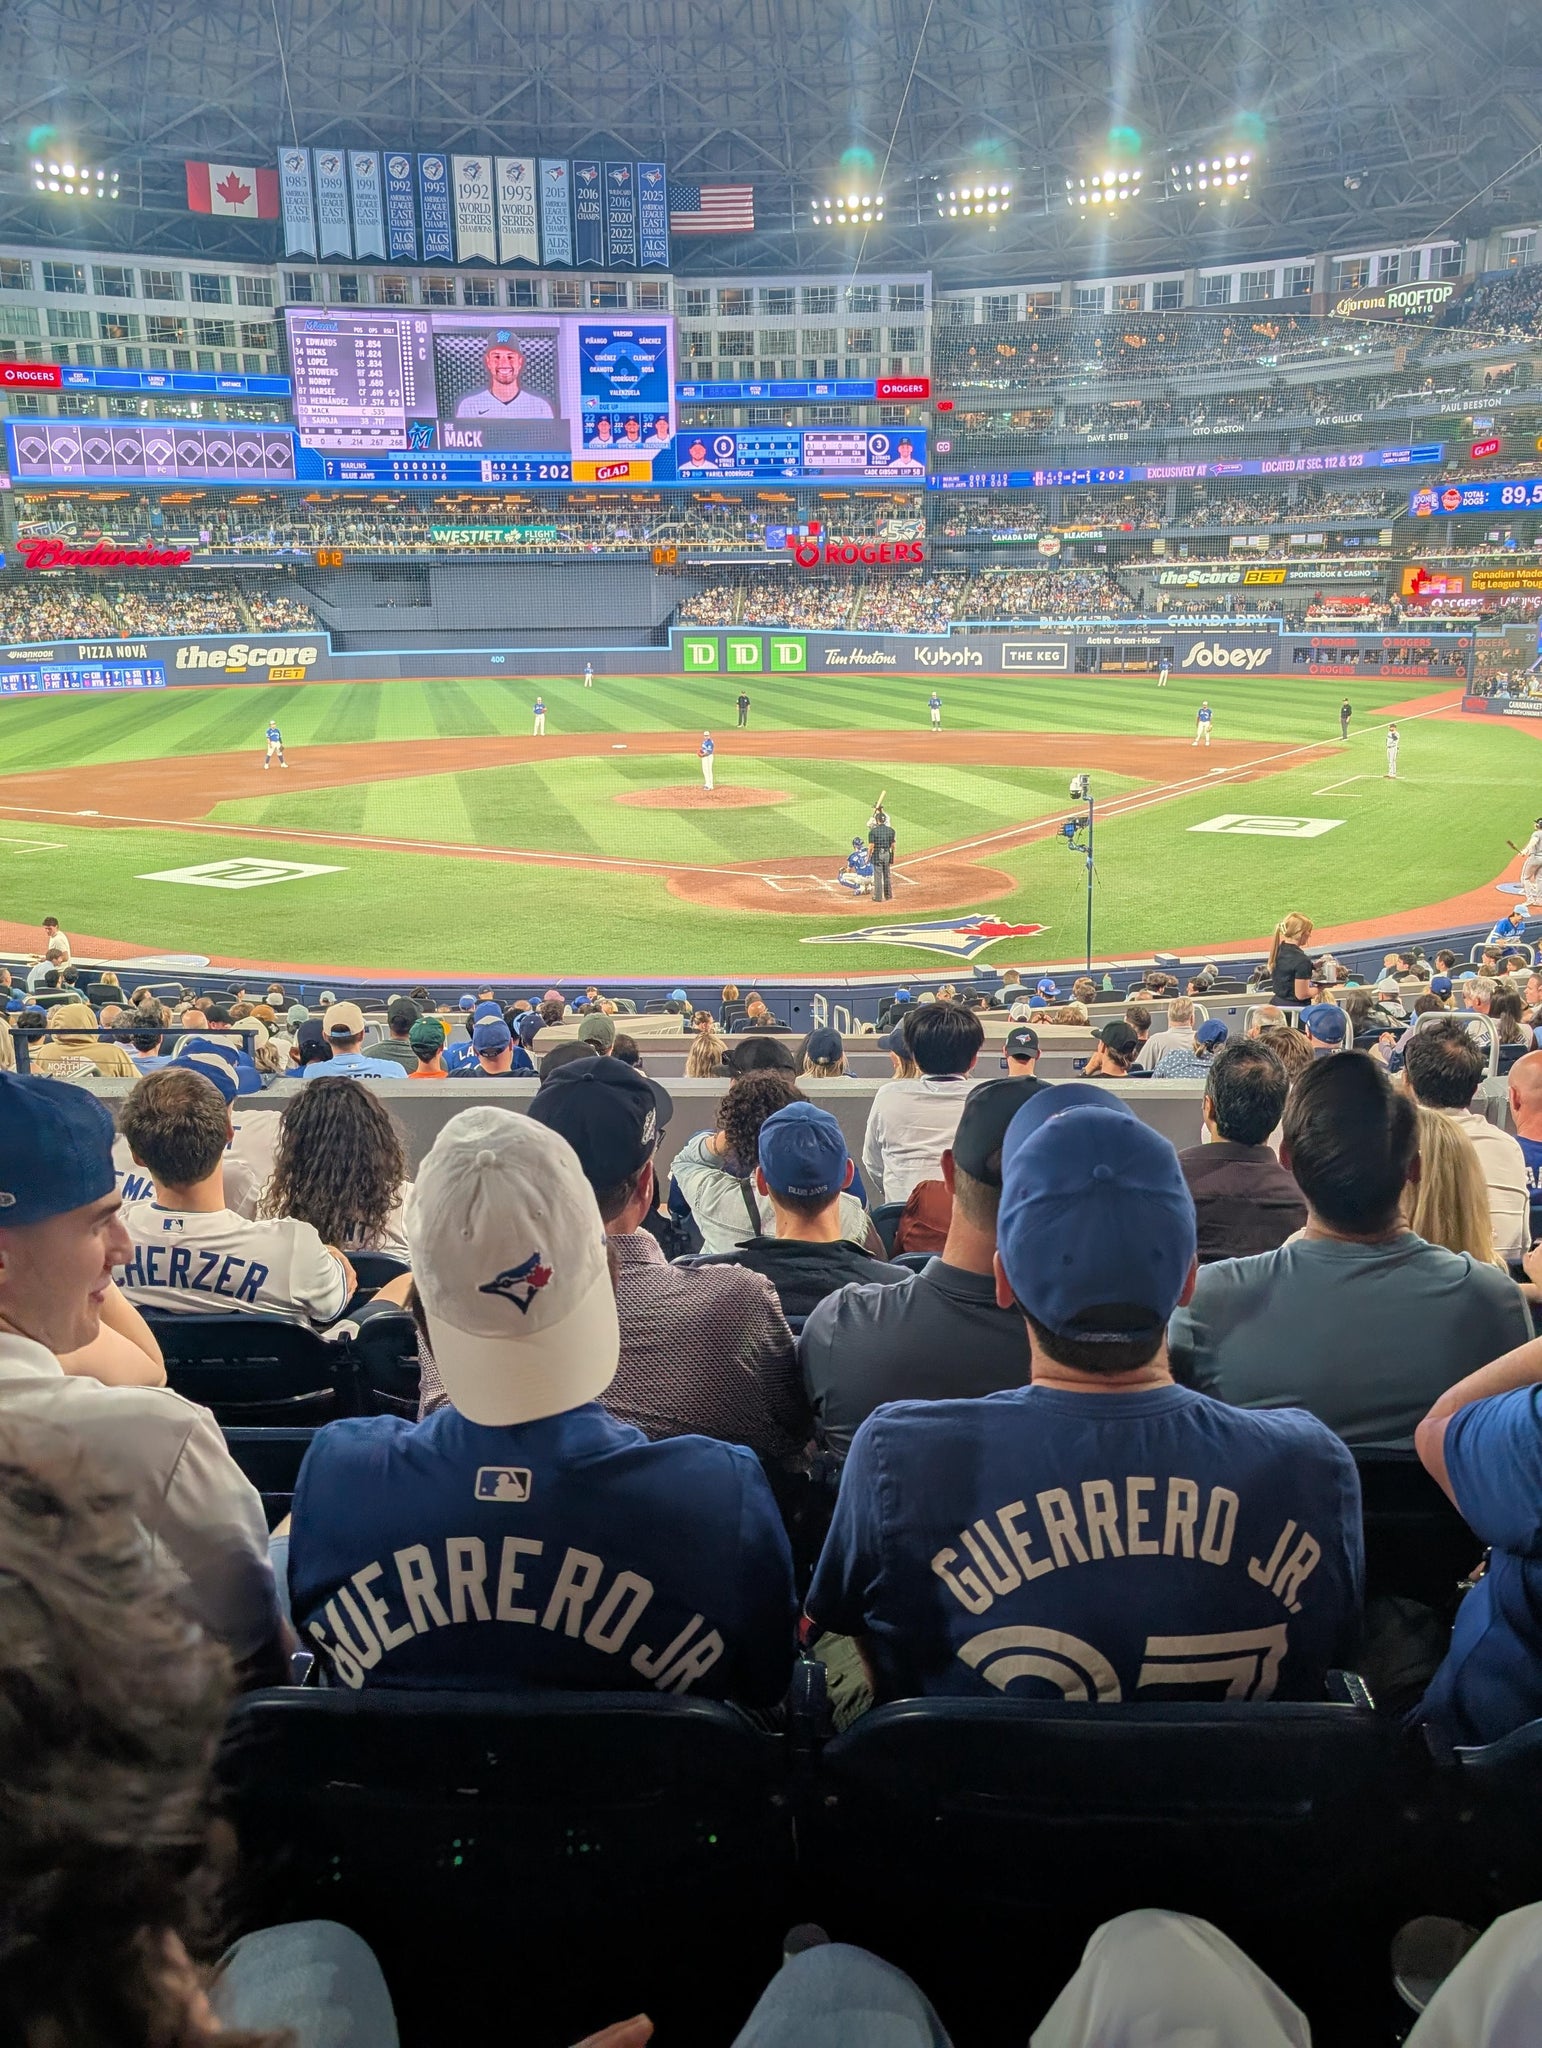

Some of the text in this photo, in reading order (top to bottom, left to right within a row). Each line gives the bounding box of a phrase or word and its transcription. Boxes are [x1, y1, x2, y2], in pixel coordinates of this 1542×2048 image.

[321, 178, 342, 189] 1989
[356, 180, 376, 190] 1991
[390, 181, 411, 191] 1992
[424, 182, 445, 193] 1993
[459, 184, 489, 200] 1992
[502, 185, 532, 201] 1993
[545, 187, 566, 198] 2015
[578, 188, 598, 199] 2016
[642, 190, 664, 201] 2025
[390, 201, 413, 209] LEAGUE
[578, 202, 600, 213] ALDS
[610, 197, 631, 207] 2016
[287, 206, 309, 215] EAST
[322, 207, 345, 217] EAST
[357, 209, 379, 218] EAST
[458, 203, 491, 214] WORLD
[501, 204, 534, 215] WORLD
[642, 210, 664, 218] LEAGUE
[391, 210, 413, 219] EAST
[425, 211, 447, 220] EAST
[459, 214, 492, 225] SERIES
[610, 212, 632, 223] 2020
[502, 216, 534, 226] SERIES
[546, 216, 567, 225] EAST
[643, 219, 664, 228] EAST
[393, 232, 414, 242] ALCS
[427, 233, 449, 244] ALCS
[611, 228, 633, 239] 2022
[547, 238, 569, 248] ALDS
[644, 240, 665, 250] ALCS
[611, 244, 633, 255] 2023
[643, 250, 666, 258] CHAMPS
[1337, 286, 1453, 316] Corona ROOFTOP
[1405, 305, 1433, 315] PATIO
[415, 320, 427, 333] 80
[305, 338, 337, 346] EDWARDS
[306, 348, 326, 356] HICKS
[419, 347, 426, 360] C
[307, 358, 328, 366] LOPEZ
[17, 372, 54, 381] ROGERS
[308, 368, 338, 376] STOWERS
[309, 378, 331, 386] NORBY
[891, 384, 923, 393] ROGERS
[1441, 398, 1502, 413] PAUL BEESTON
[1315, 414, 1363, 426] PAT GILLICK
[1193, 425, 1244, 436] CITO GASTON
[444, 431, 483, 447] MACK
[1087, 433, 1128, 442] DAVE STIEB
[938, 443, 949, 451] CC
[1474, 443, 1496, 455] GLAD
[597, 464, 630, 479] GLAD
[1147, 455, 1362, 478] EXCLUSIVELY AT LOCATED AT SEC. 112 & 123
[1463, 498, 1484, 506] DOGS
[1023, 533, 1038, 541] DRY
[1063, 531, 1103, 539] BLEACHERS
[16, 537, 192, 569] Budweiser
[655, 549, 676, 563] 0:12
[825, 542, 923, 565] ROGERS
[318, 553, 342, 566] 0:12
[1160, 570, 1284, 586] theScore BET
[1290, 571, 1335, 579] SPORTSBOOK
[1473, 570, 1514, 579] Canadian
[1472, 581, 1485, 590] Big
[1488, 580, 1520, 589] League
[1393, 638, 1431, 647] ROGERS
[79, 645, 146, 660] PIZZA NOVA
[176, 644, 318, 669] theScore
[688, 643, 715, 665] TD
[731, 643, 758, 665] TD
[774, 643, 802, 665] TD
[825, 648, 896, 665] Tim Hortons
[915, 647, 982, 666] Kubota
[1010, 651, 1060, 661] THE KEG
[1182, 641, 1271, 670] Sobeys
[490, 655, 505, 664] 400
[273, 669, 302, 680] BET
[1320, 666, 1355, 674] ROGERS
[1392, 666, 1429, 675] ROGERS
[788, 1184, 828, 1196] BLUE JAYS
[930, 1477, 1320, 1615] GUERRERO JR.
[309, 1536, 654, 1690] GUERRERO
